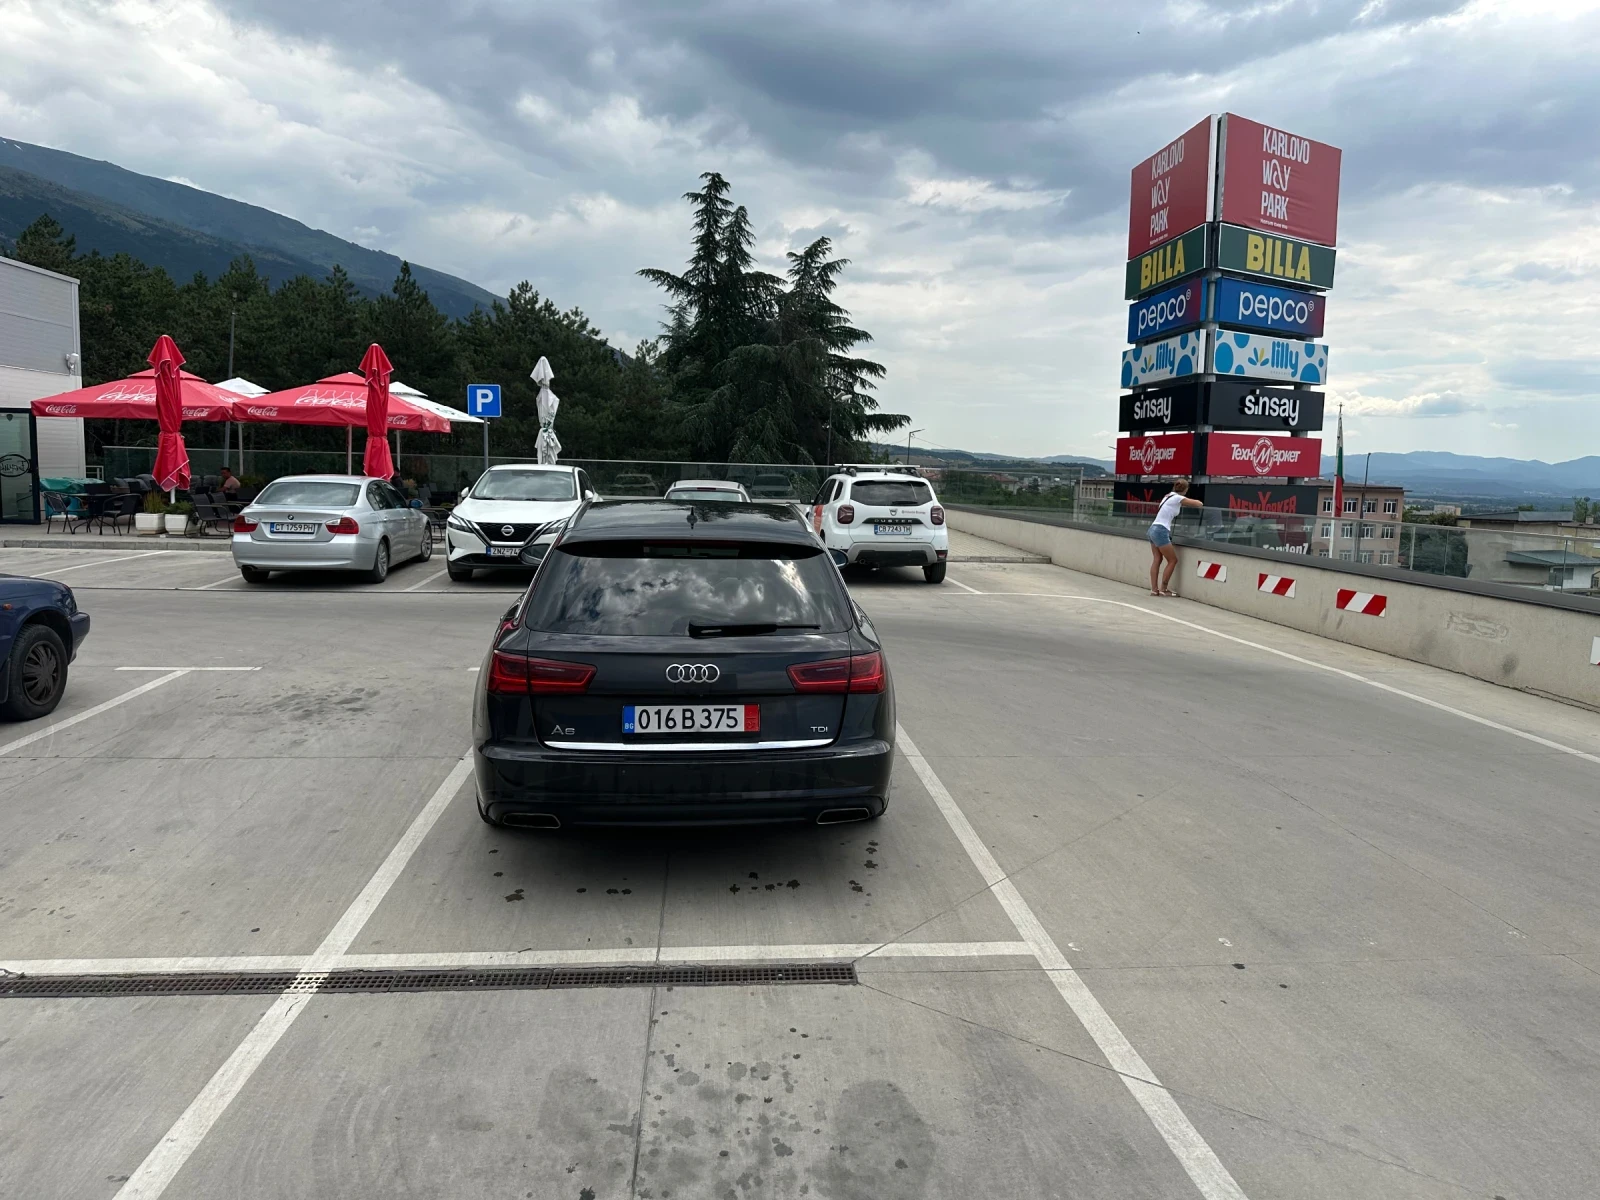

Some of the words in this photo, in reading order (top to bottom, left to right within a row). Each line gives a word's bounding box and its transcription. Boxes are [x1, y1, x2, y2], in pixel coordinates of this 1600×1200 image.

[1151, 138, 1185, 181] KARLOVO
[1263, 127, 1310, 165] KARLOVO
[1262, 159, 1291, 192] WAY
[1149, 206, 1169, 238] PARK
[1260, 190, 1289, 221] PARK
[1140, 239, 1186, 291] BILLA
[1246, 233, 1311, 282] BILLA
[1155, 342, 1176, 375] lilly
[1270, 341, 1299, 378] lilly
[476, 389, 494, 413] P
[1133, 395, 1172, 424] sinsay
[1244, 389, 1300, 427] sinsay
[551, 725, 575, 735] A6
[624, 722, 634, 730] BG
